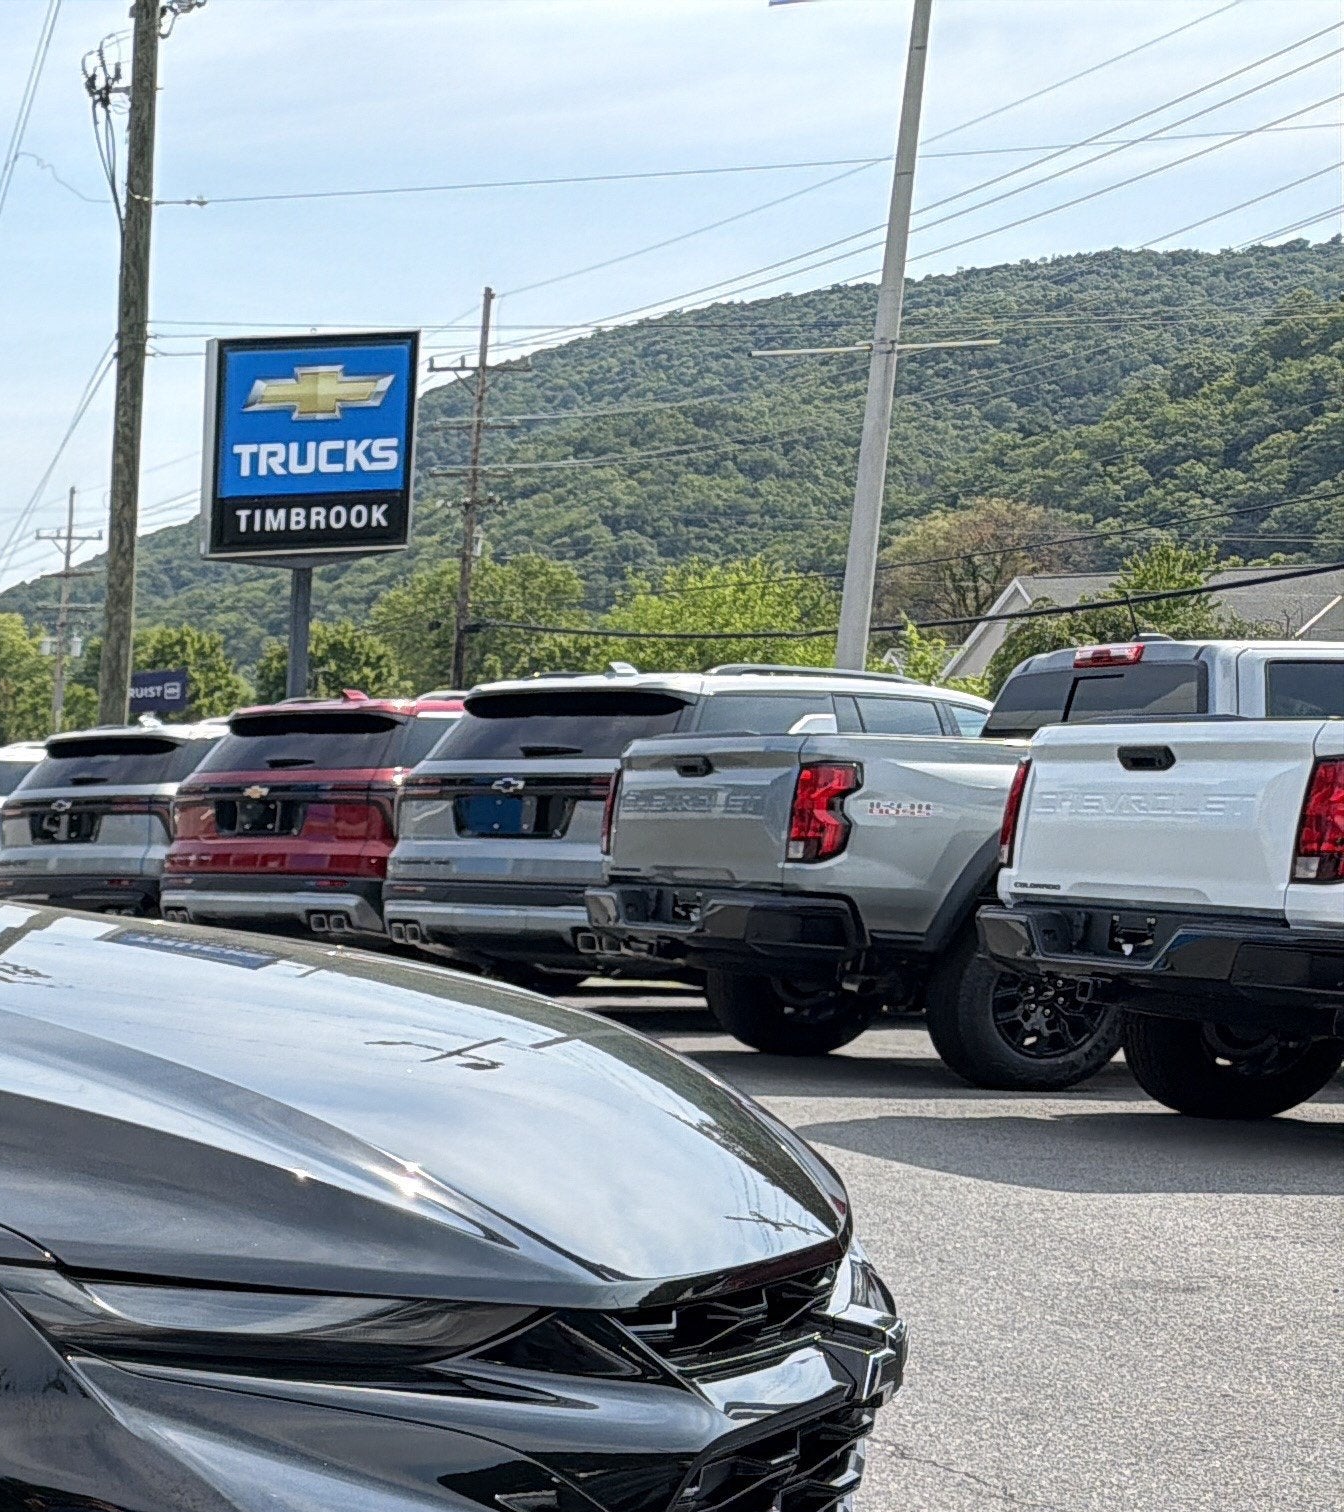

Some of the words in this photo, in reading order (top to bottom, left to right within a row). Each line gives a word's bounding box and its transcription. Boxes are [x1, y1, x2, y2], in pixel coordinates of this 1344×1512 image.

[232, 437, 399, 477] TRUCKS
[235, 503, 389, 533] TIMBROOK
[127, 685, 163, 699] RUIST
